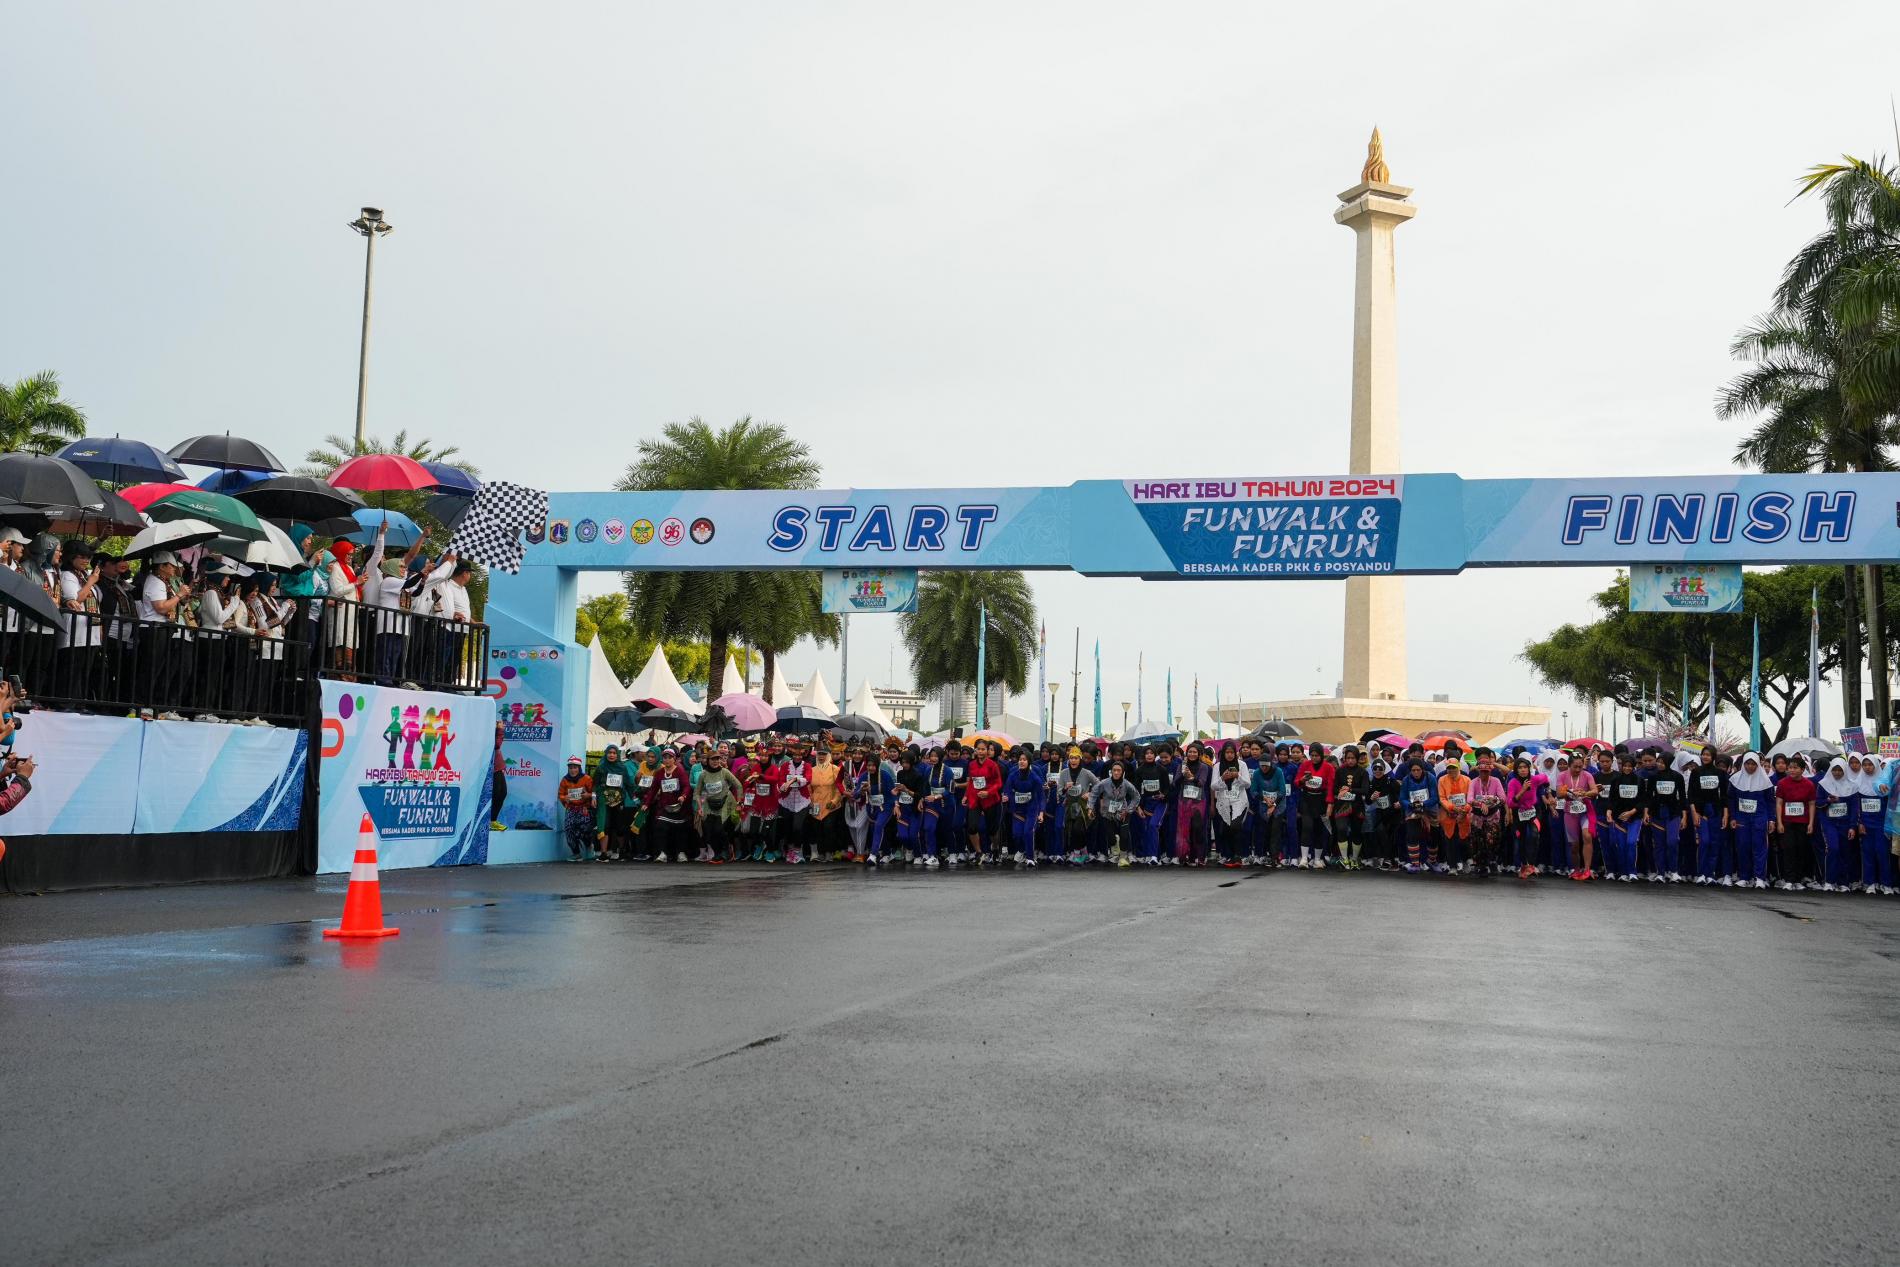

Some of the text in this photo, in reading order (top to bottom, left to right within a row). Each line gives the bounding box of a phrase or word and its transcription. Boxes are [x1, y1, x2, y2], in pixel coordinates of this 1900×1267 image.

[1133, 479, 1395, 499] HARI IBU TAHUN 2024
[1182, 506, 1380, 532] FUNWALK &
[1561, 491, 1856, 545] FINISH
[664, 525, 680, 539] 96
[767, 505, 999, 552] START
[1232, 533, 1380, 559] FUNRUN
[1183, 562, 1391, 573] BERSAMA KADER PKK & POSYANDU
[505, 767, 542, 777] Minerale
[520, 758, 531, 768] Le
[407, 769, 437, 781] TAHUN
[438, 770, 461, 781] 2024
[383, 788, 452, 806] FUNWALK &
[398, 807, 450, 825] FUNRUN
